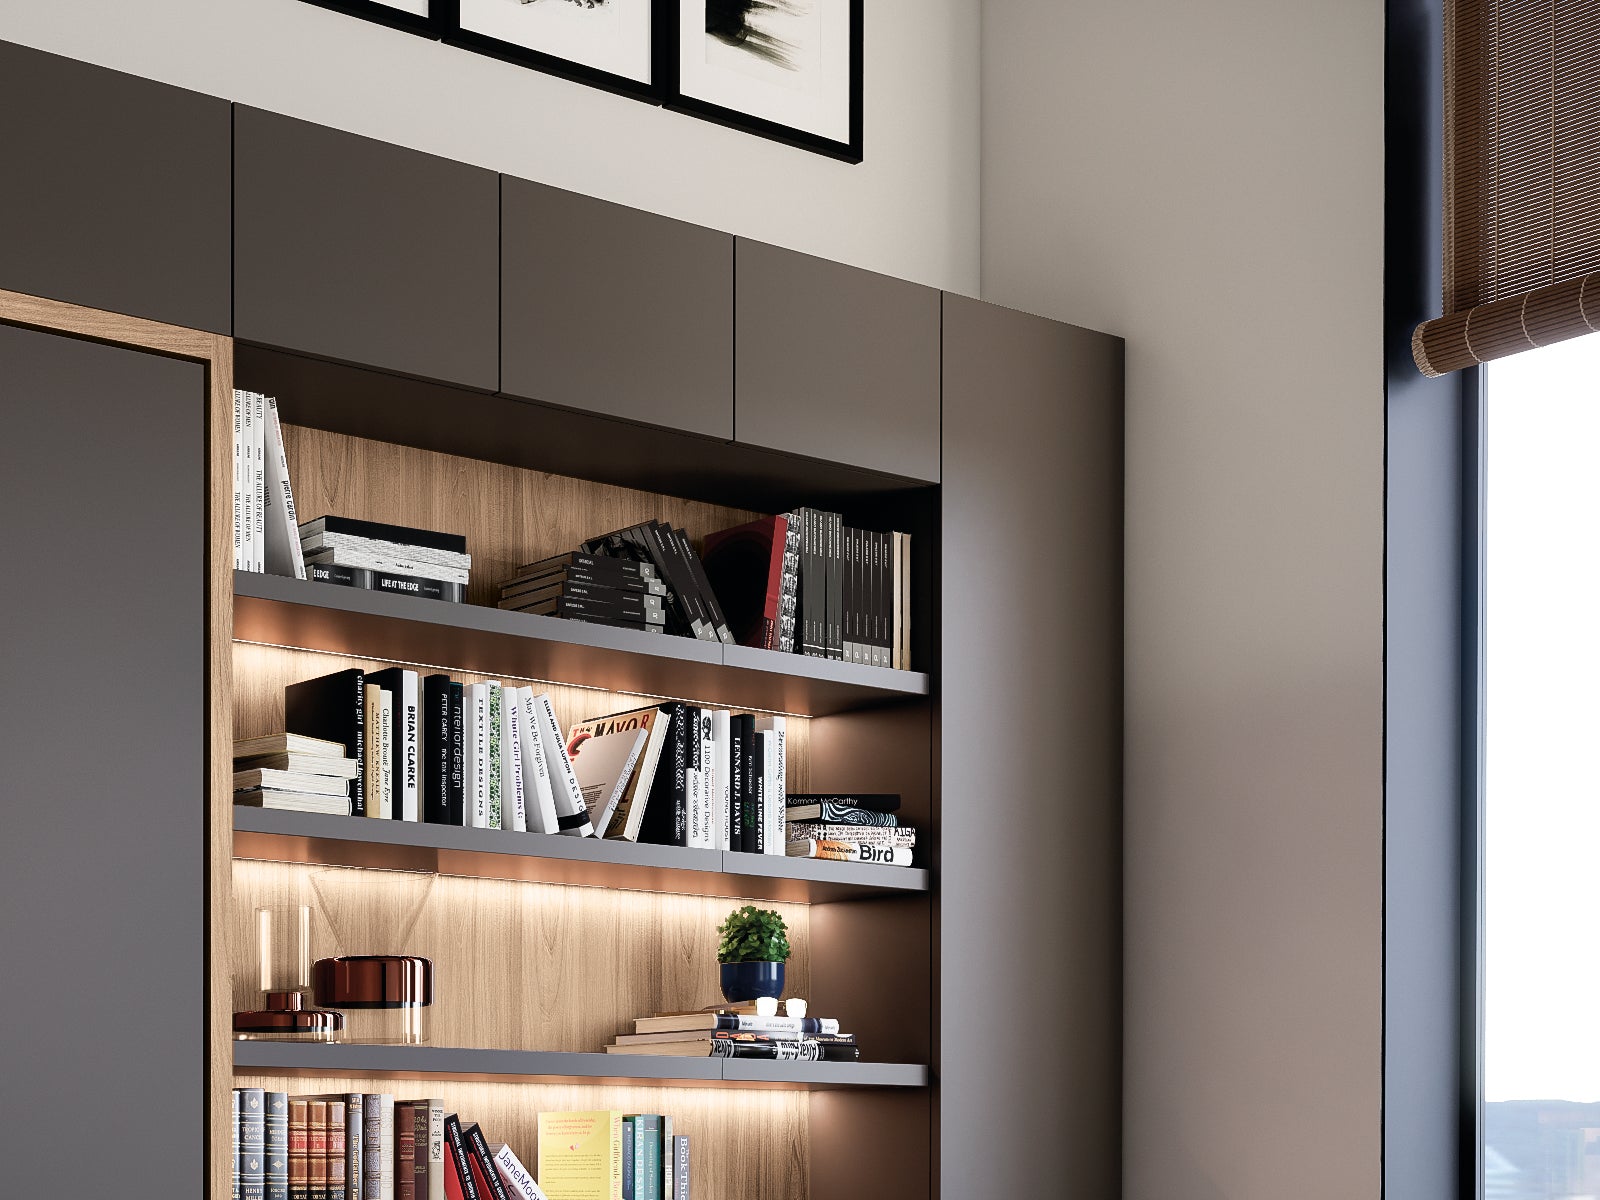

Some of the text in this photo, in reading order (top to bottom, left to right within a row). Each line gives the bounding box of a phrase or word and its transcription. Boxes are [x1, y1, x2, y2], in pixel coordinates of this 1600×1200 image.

[280, 480, 297, 521] pierre cardin
[381, 578, 419, 592] LIFE EDGE
[355, 675, 364, 706] charity
[355, 708, 364, 725] girl
[382, 708, 390, 741] Charlotte
[407, 705, 415, 789] BRIAN CLARKE
[452, 705, 462, 788] nteriordesign
[512, 741, 521, 762] Girl
[524, 697, 546, 778] May We Be Forgiven
[543, 700, 584, 812] ELLEN AND LUPTON DESIG
[514, 764, 523, 809] Problems
[733, 737, 741, 835] LENNARD DAVIS
[820, 797, 858, 806] McCarthy
[859, 844, 894, 862] Bird
[352, 1149, 360, 1187] Godfather
[636, 1119, 644, 1198] KIRAN DESAI
[680, 1137, 688, 1171] Book
